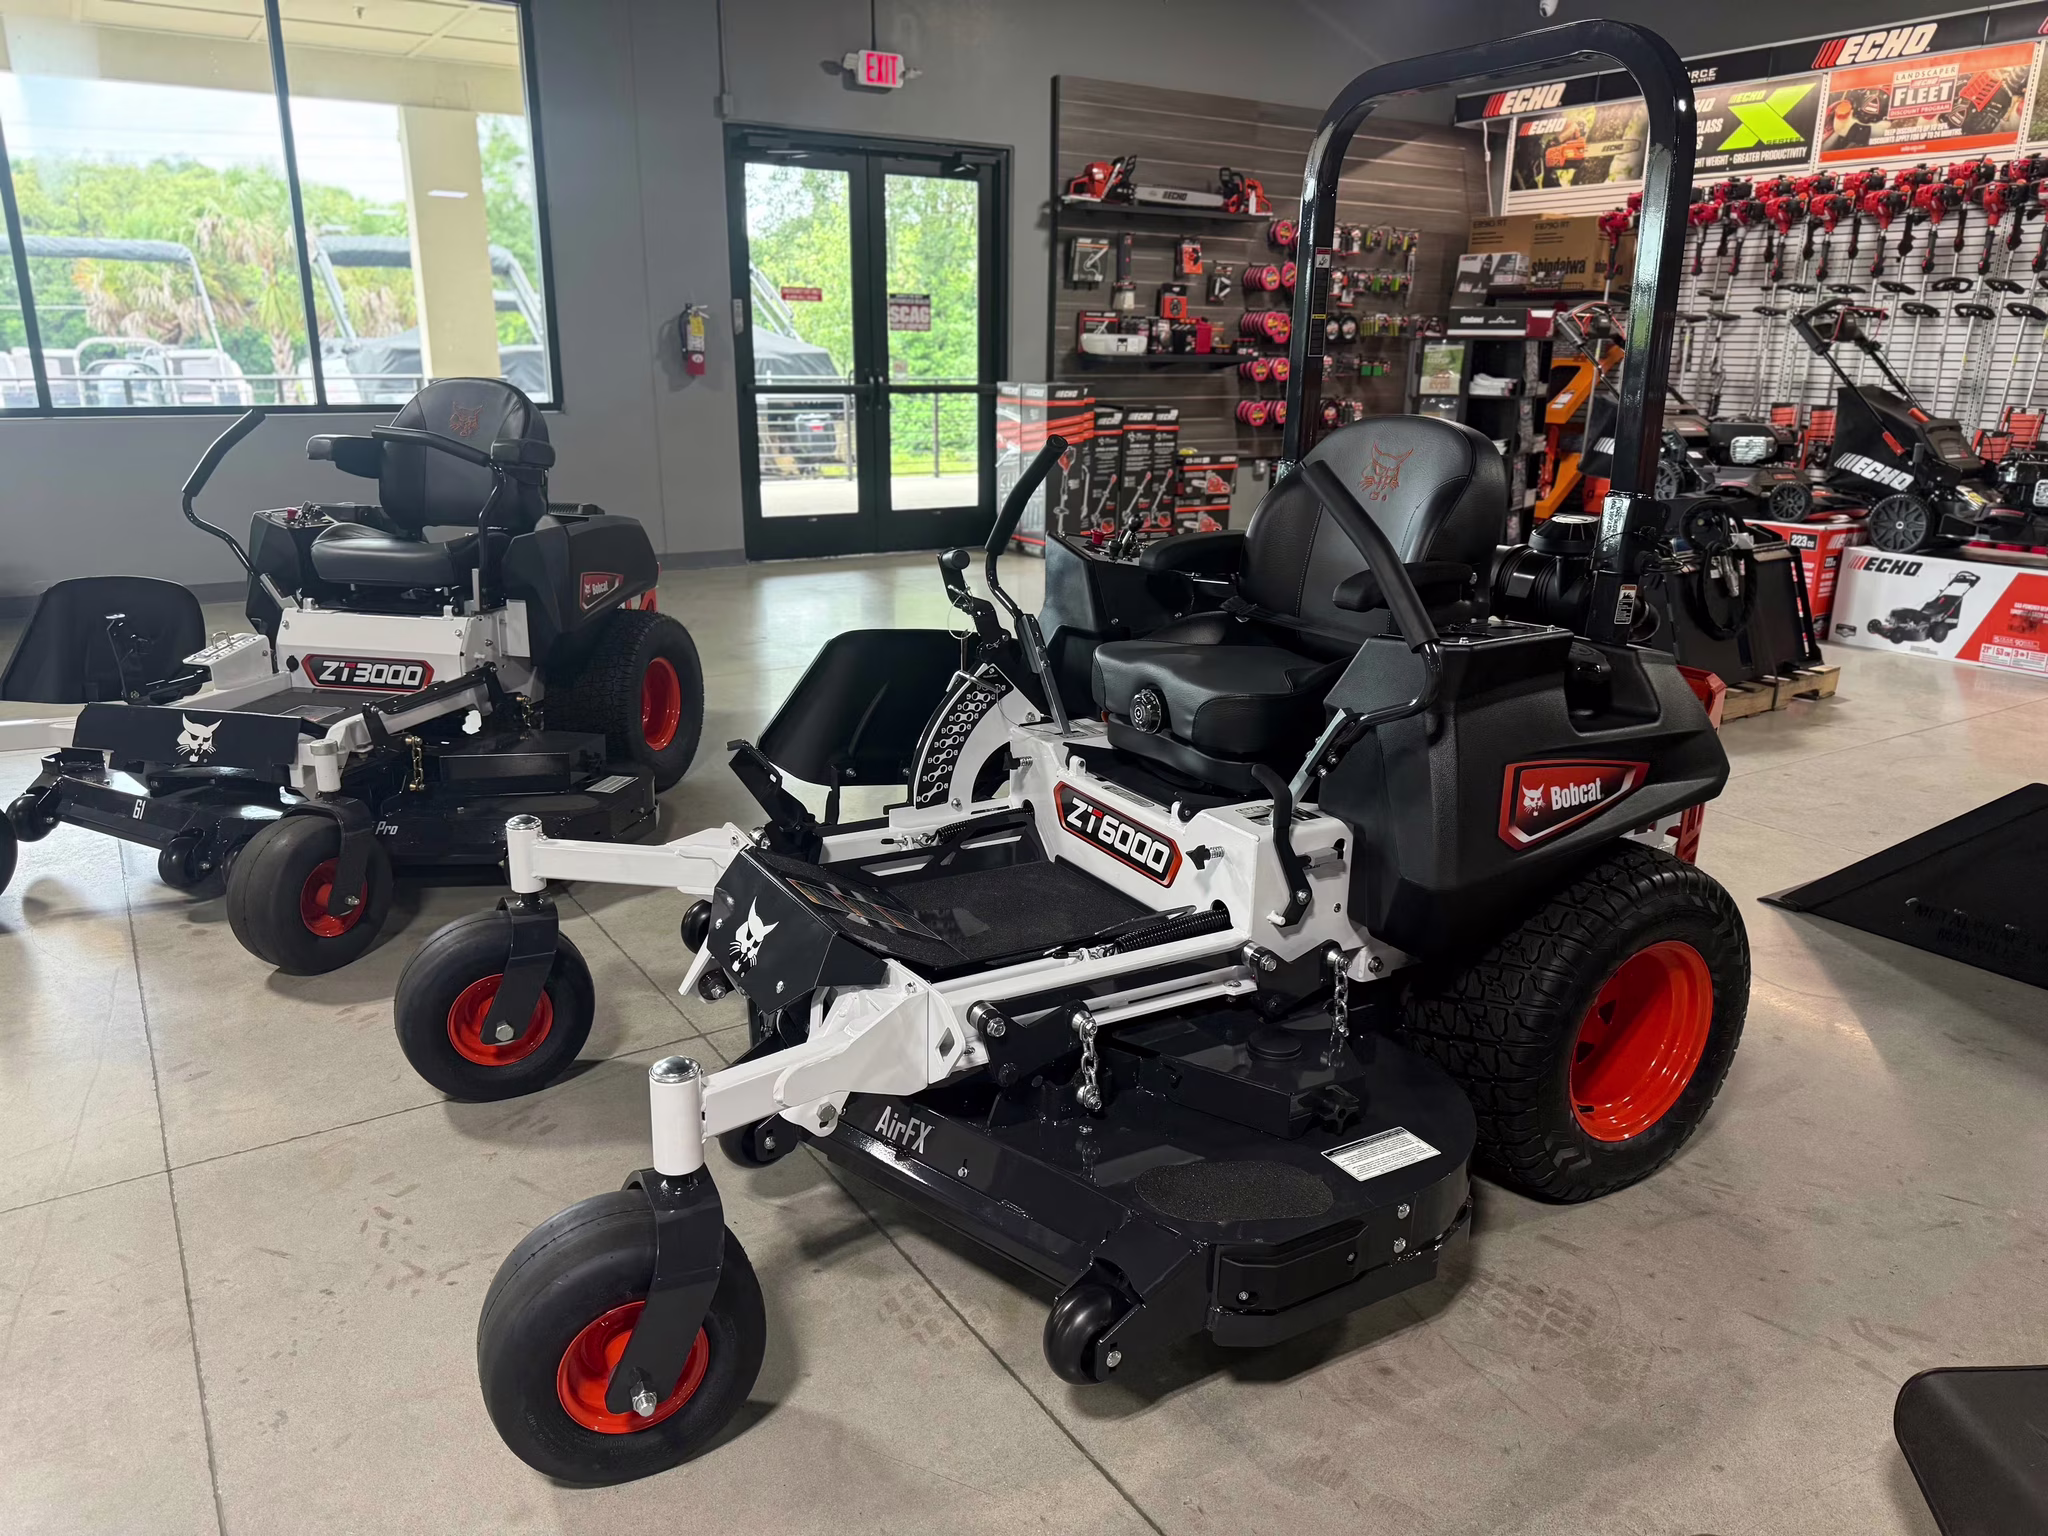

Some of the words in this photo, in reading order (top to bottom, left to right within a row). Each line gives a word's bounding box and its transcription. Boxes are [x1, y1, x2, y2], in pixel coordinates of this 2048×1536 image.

[1836, 23, 1938, 65] ECHO
[866, 52, 898, 86] EXIT
[1687, 67, 1718, 79] RCE
[1895, 66, 1956, 81] LANDSCAPER
[1500, 82, 1567, 115] ECHO
[1733, 90, 1767, 103] ECHO
[1893, 82, 1953, 107] FLEET
[1890, 107, 1920, 116] DISCOUNT
[1920, 104, 1950, 113] PROGRAM
[1529, 118, 1567, 135] ECHO
[1896, 125, 1923, 135] DISCOUNTS
[1765, 137, 1802, 146] SERIES
[1868, 136, 1895, 146] DISCOUNTS
[1895, 134, 1910, 143] APPLY
[1919, 132, 1928, 140] UP
[1705, 154, 1729, 167] WEIGHT
[1732, 151, 1760, 165] GREATER
[1760, 146, 1808, 162] PRODUCTIVITY
[1168, 191, 1187, 200] ECHO
[1531, 257, 1586, 276] shindaiwa
[890, 305, 930, 323] SCAG
[1851, 456, 1915, 491] ECHO
[1790, 534, 1808, 547] 223
[1863, 556, 1924, 577] ECHO
[592, 580, 609, 595] Bobcat
[319, 661, 423, 686] ZT3000
[1550, 777, 1602, 811] Bobcat
[132, 798, 147, 820] 61
[375, 821, 399, 835] Pro
[1066, 796, 1170, 874] ZT6000
[874, 1105, 935, 1154] AirFX
